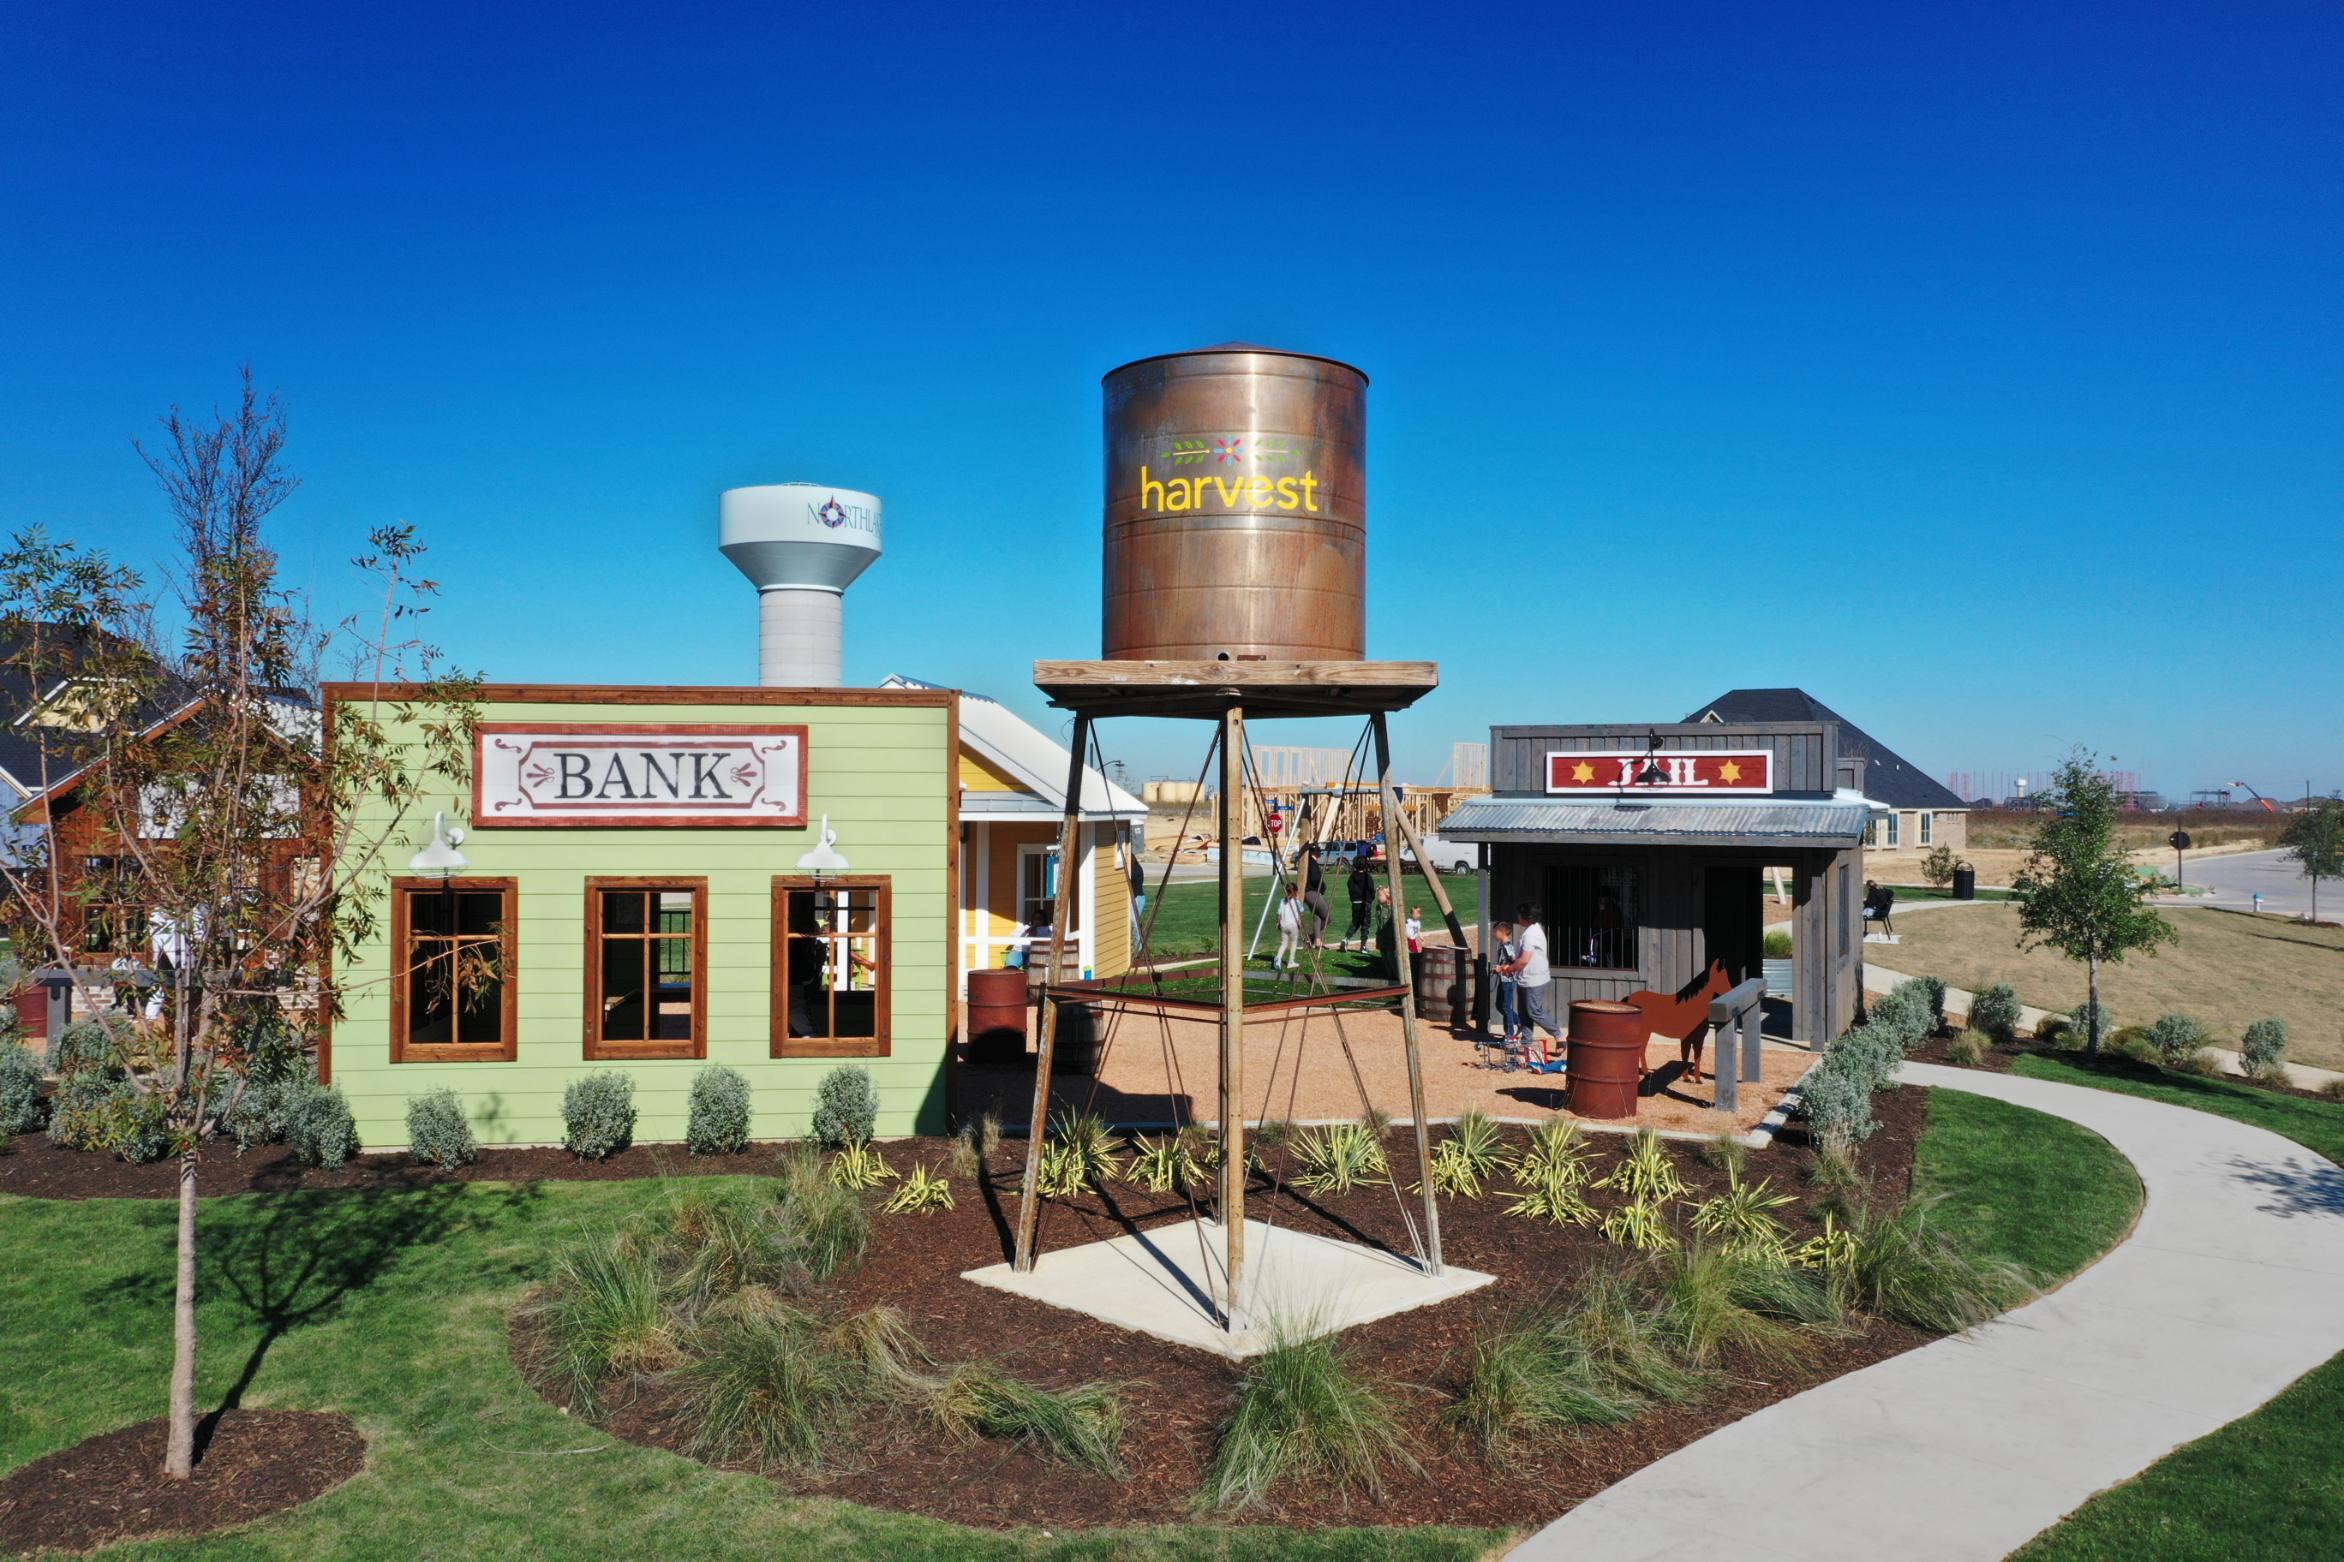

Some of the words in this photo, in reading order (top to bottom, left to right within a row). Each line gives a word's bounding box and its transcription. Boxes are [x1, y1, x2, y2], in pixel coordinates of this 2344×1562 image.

[1141, 465, 1318, 512] harvest
[553, 751, 733, 799] BANK
[1269, 819, 1282, 828] TOP
